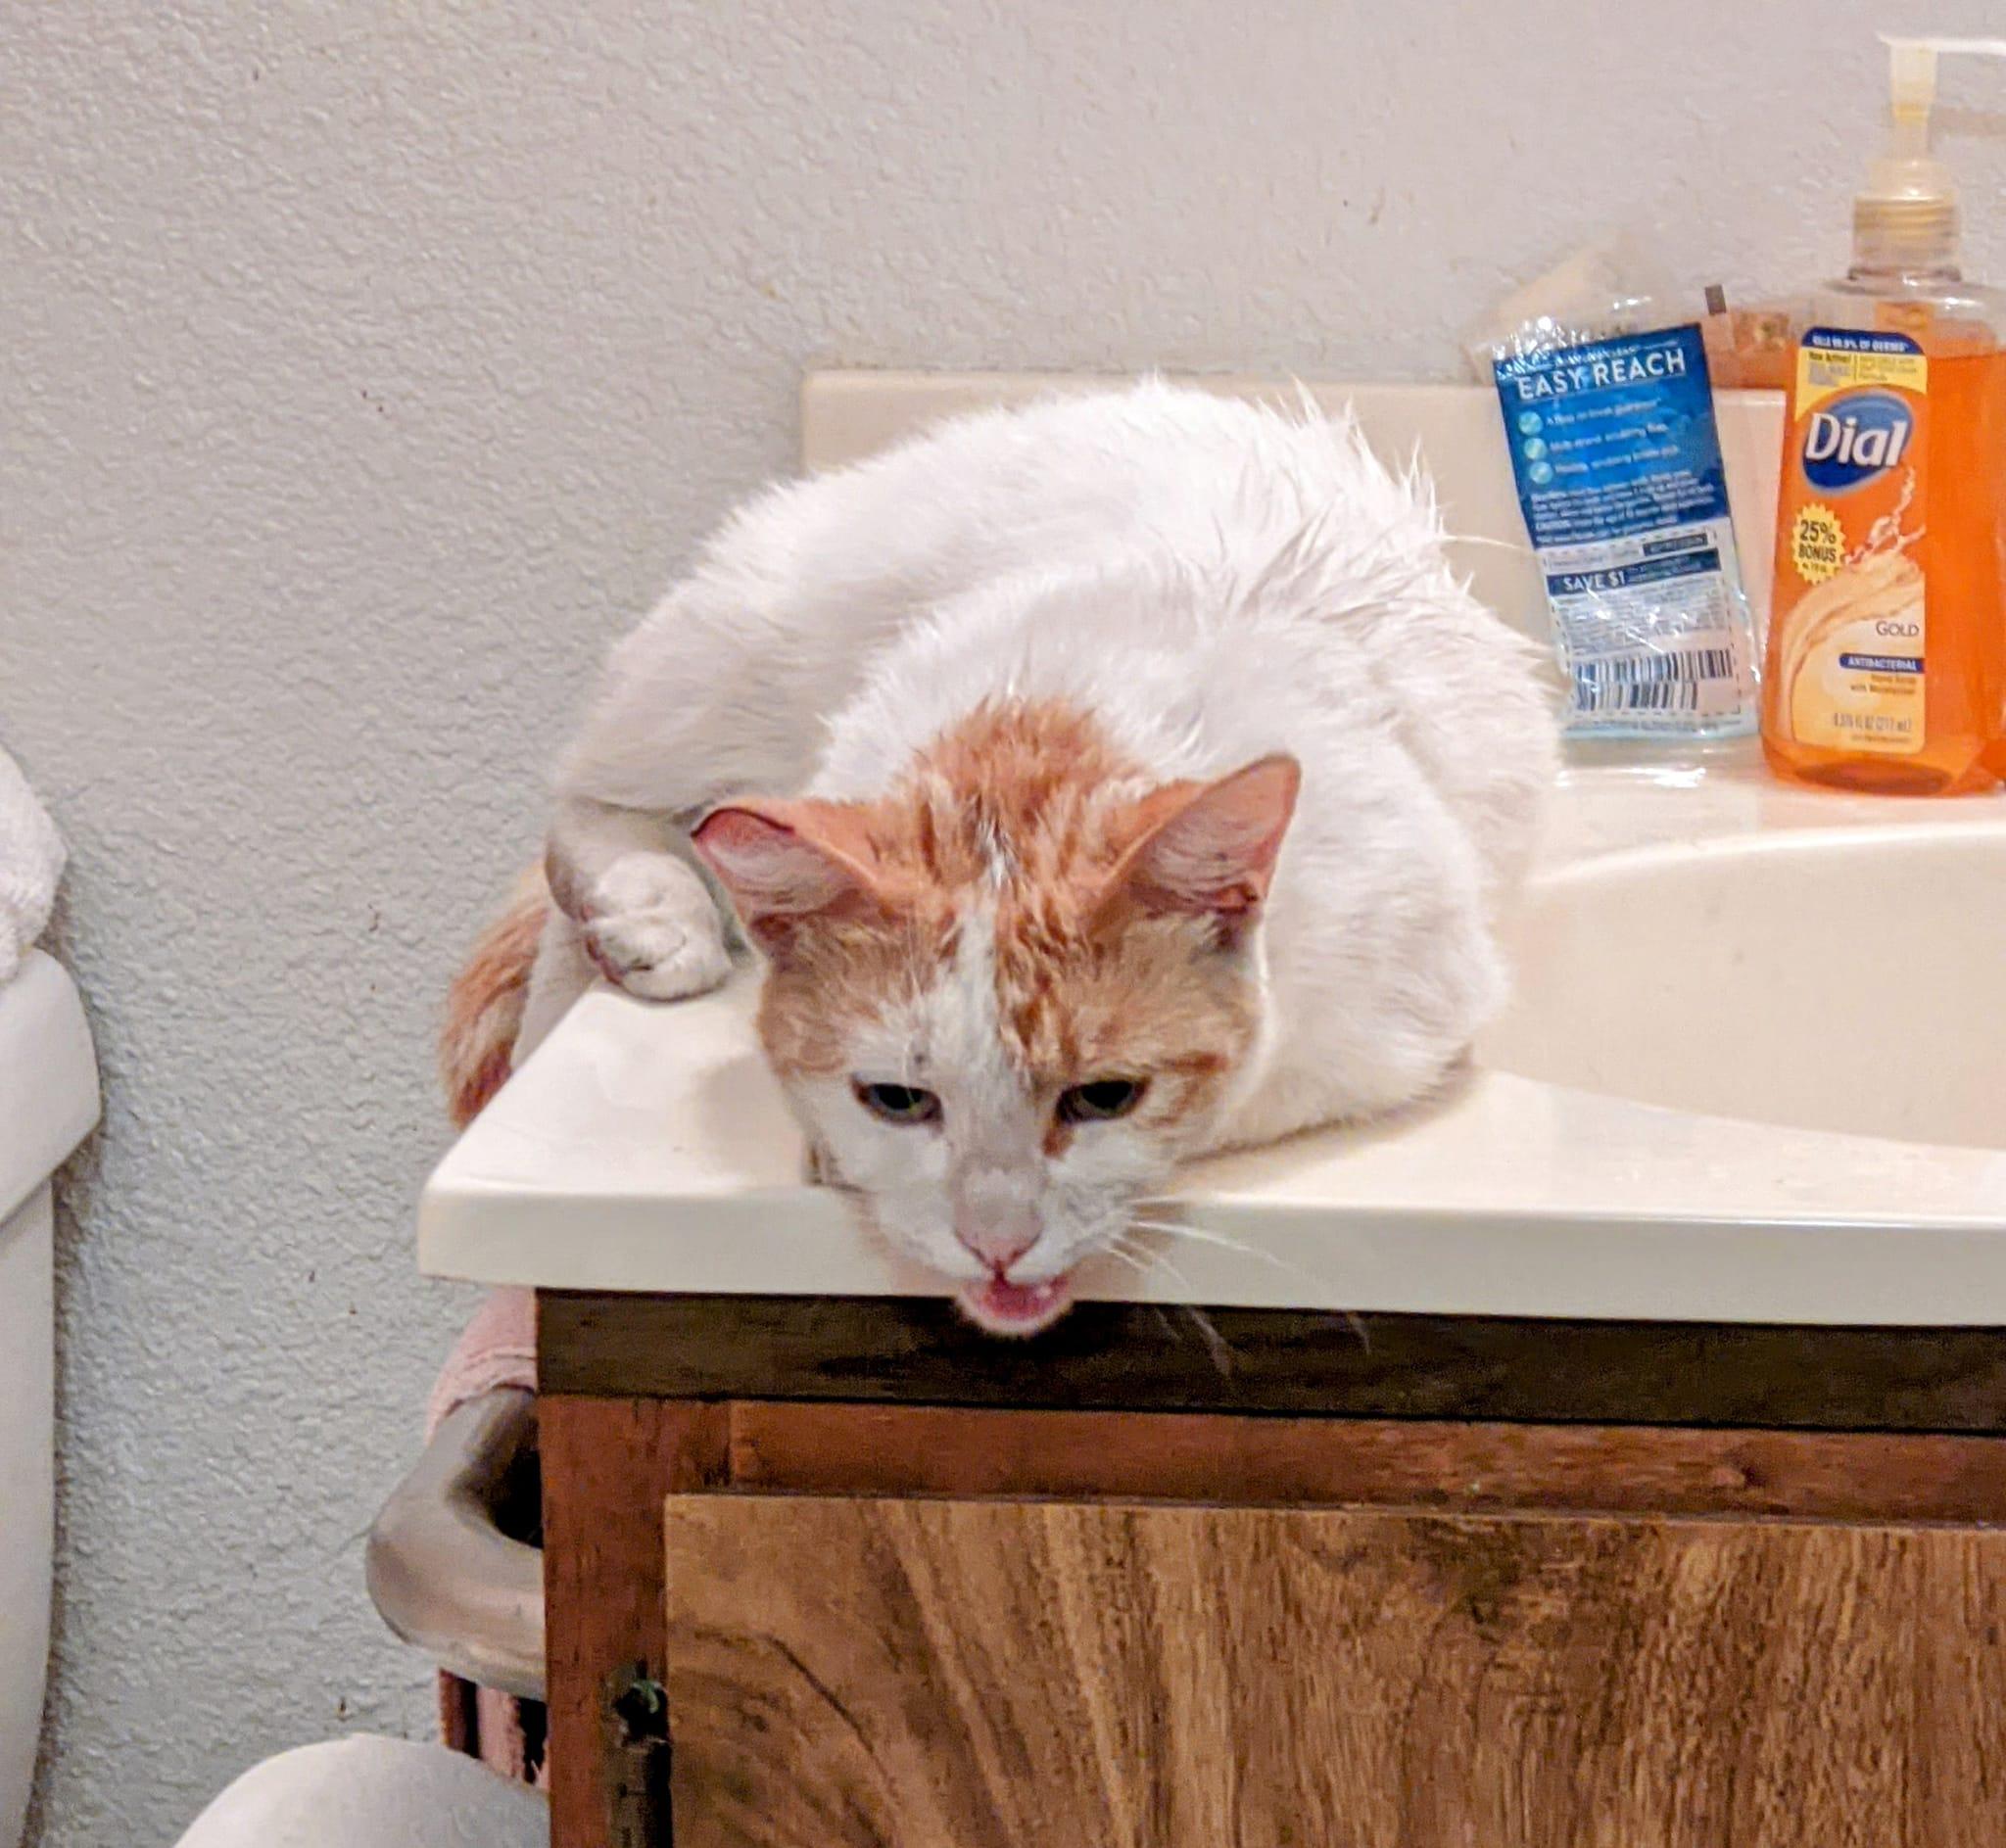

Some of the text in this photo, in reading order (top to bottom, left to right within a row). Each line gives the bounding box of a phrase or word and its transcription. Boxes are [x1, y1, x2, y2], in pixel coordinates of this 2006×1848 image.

[1519, 368, 1583, 400] EASY
[1592, 347, 1687, 387] REACH
[1805, 412, 1907, 466] Dial
[1799, 518, 1838, 545] 25%
[1798, 543, 1838, 564] BONUS
[1562, 572, 1605, 592] SAVE
[1876, 620, 1920, 637] GOLD
